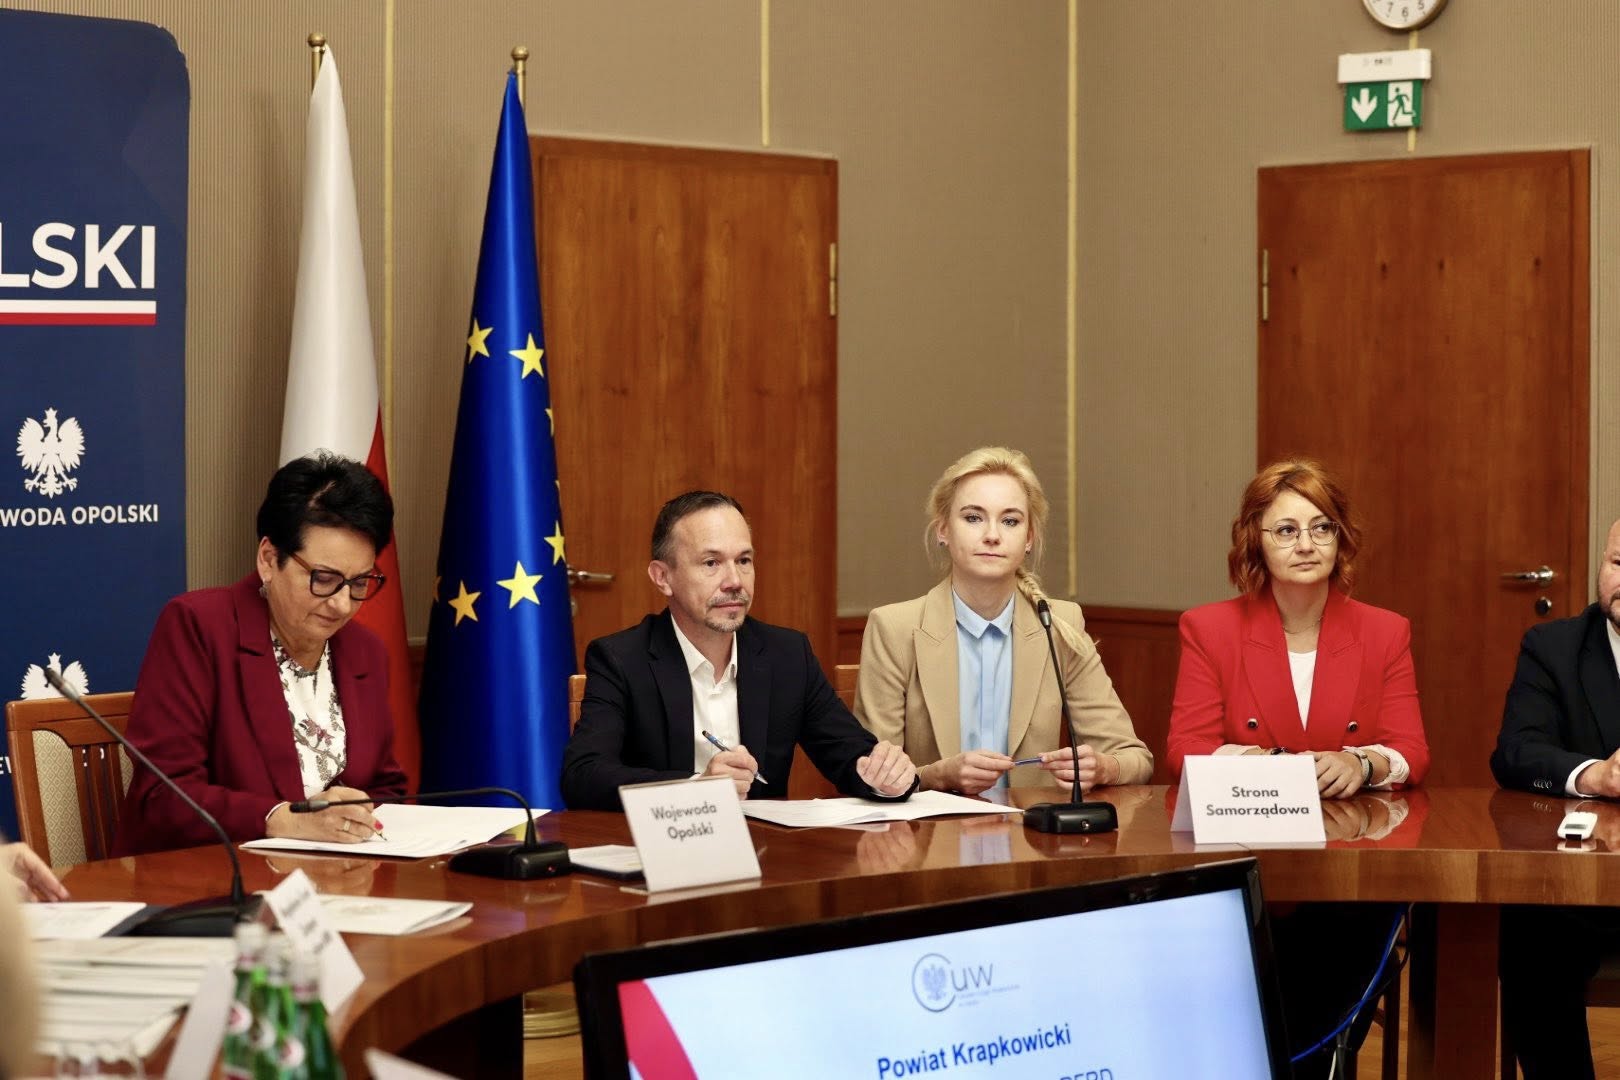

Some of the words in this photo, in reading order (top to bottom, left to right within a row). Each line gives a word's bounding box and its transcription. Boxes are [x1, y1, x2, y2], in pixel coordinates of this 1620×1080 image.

[1402, 7, 1409, 17] 6
[71, 504, 158, 525] OPOLSKI
[1231, 786, 1279, 798] Strona
[650, 801, 717, 822] Wojewoda
[1206, 803, 1310, 818] Samorządowa
[667, 822, 714, 841] Opolski
[877, 1050, 947, 1079] Powiat
[952, 1023, 1071, 1066] Krapkowicki
